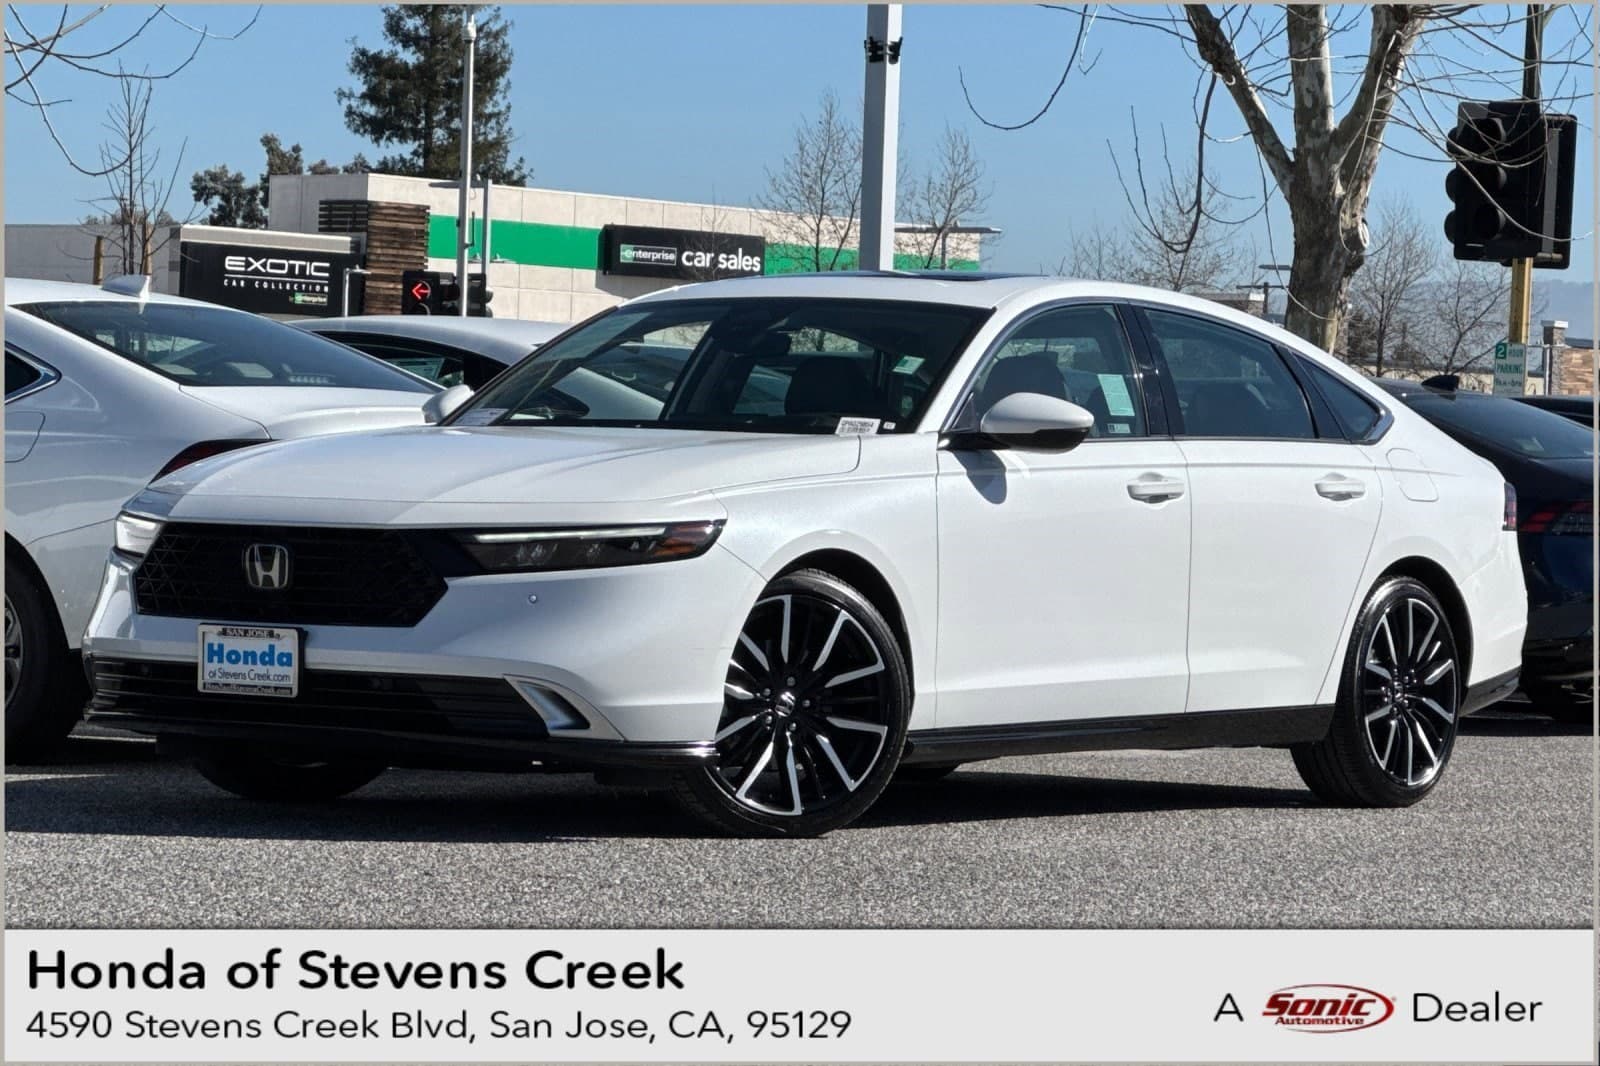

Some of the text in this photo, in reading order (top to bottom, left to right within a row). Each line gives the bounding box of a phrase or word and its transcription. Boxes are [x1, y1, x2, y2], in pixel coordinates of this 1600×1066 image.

[225, 256, 330, 277] EXOTIC
[622, 247, 761, 272] enterprise car sales
[224, 279, 329, 293] CAR COLLECTION
[1497, 345, 1505, 358] 2
[225, 628, 270, 638] SAN JOSE
[207, 642, 293, 667] Honda
[208, 668, 290, 682] of Stevens Creek.com
